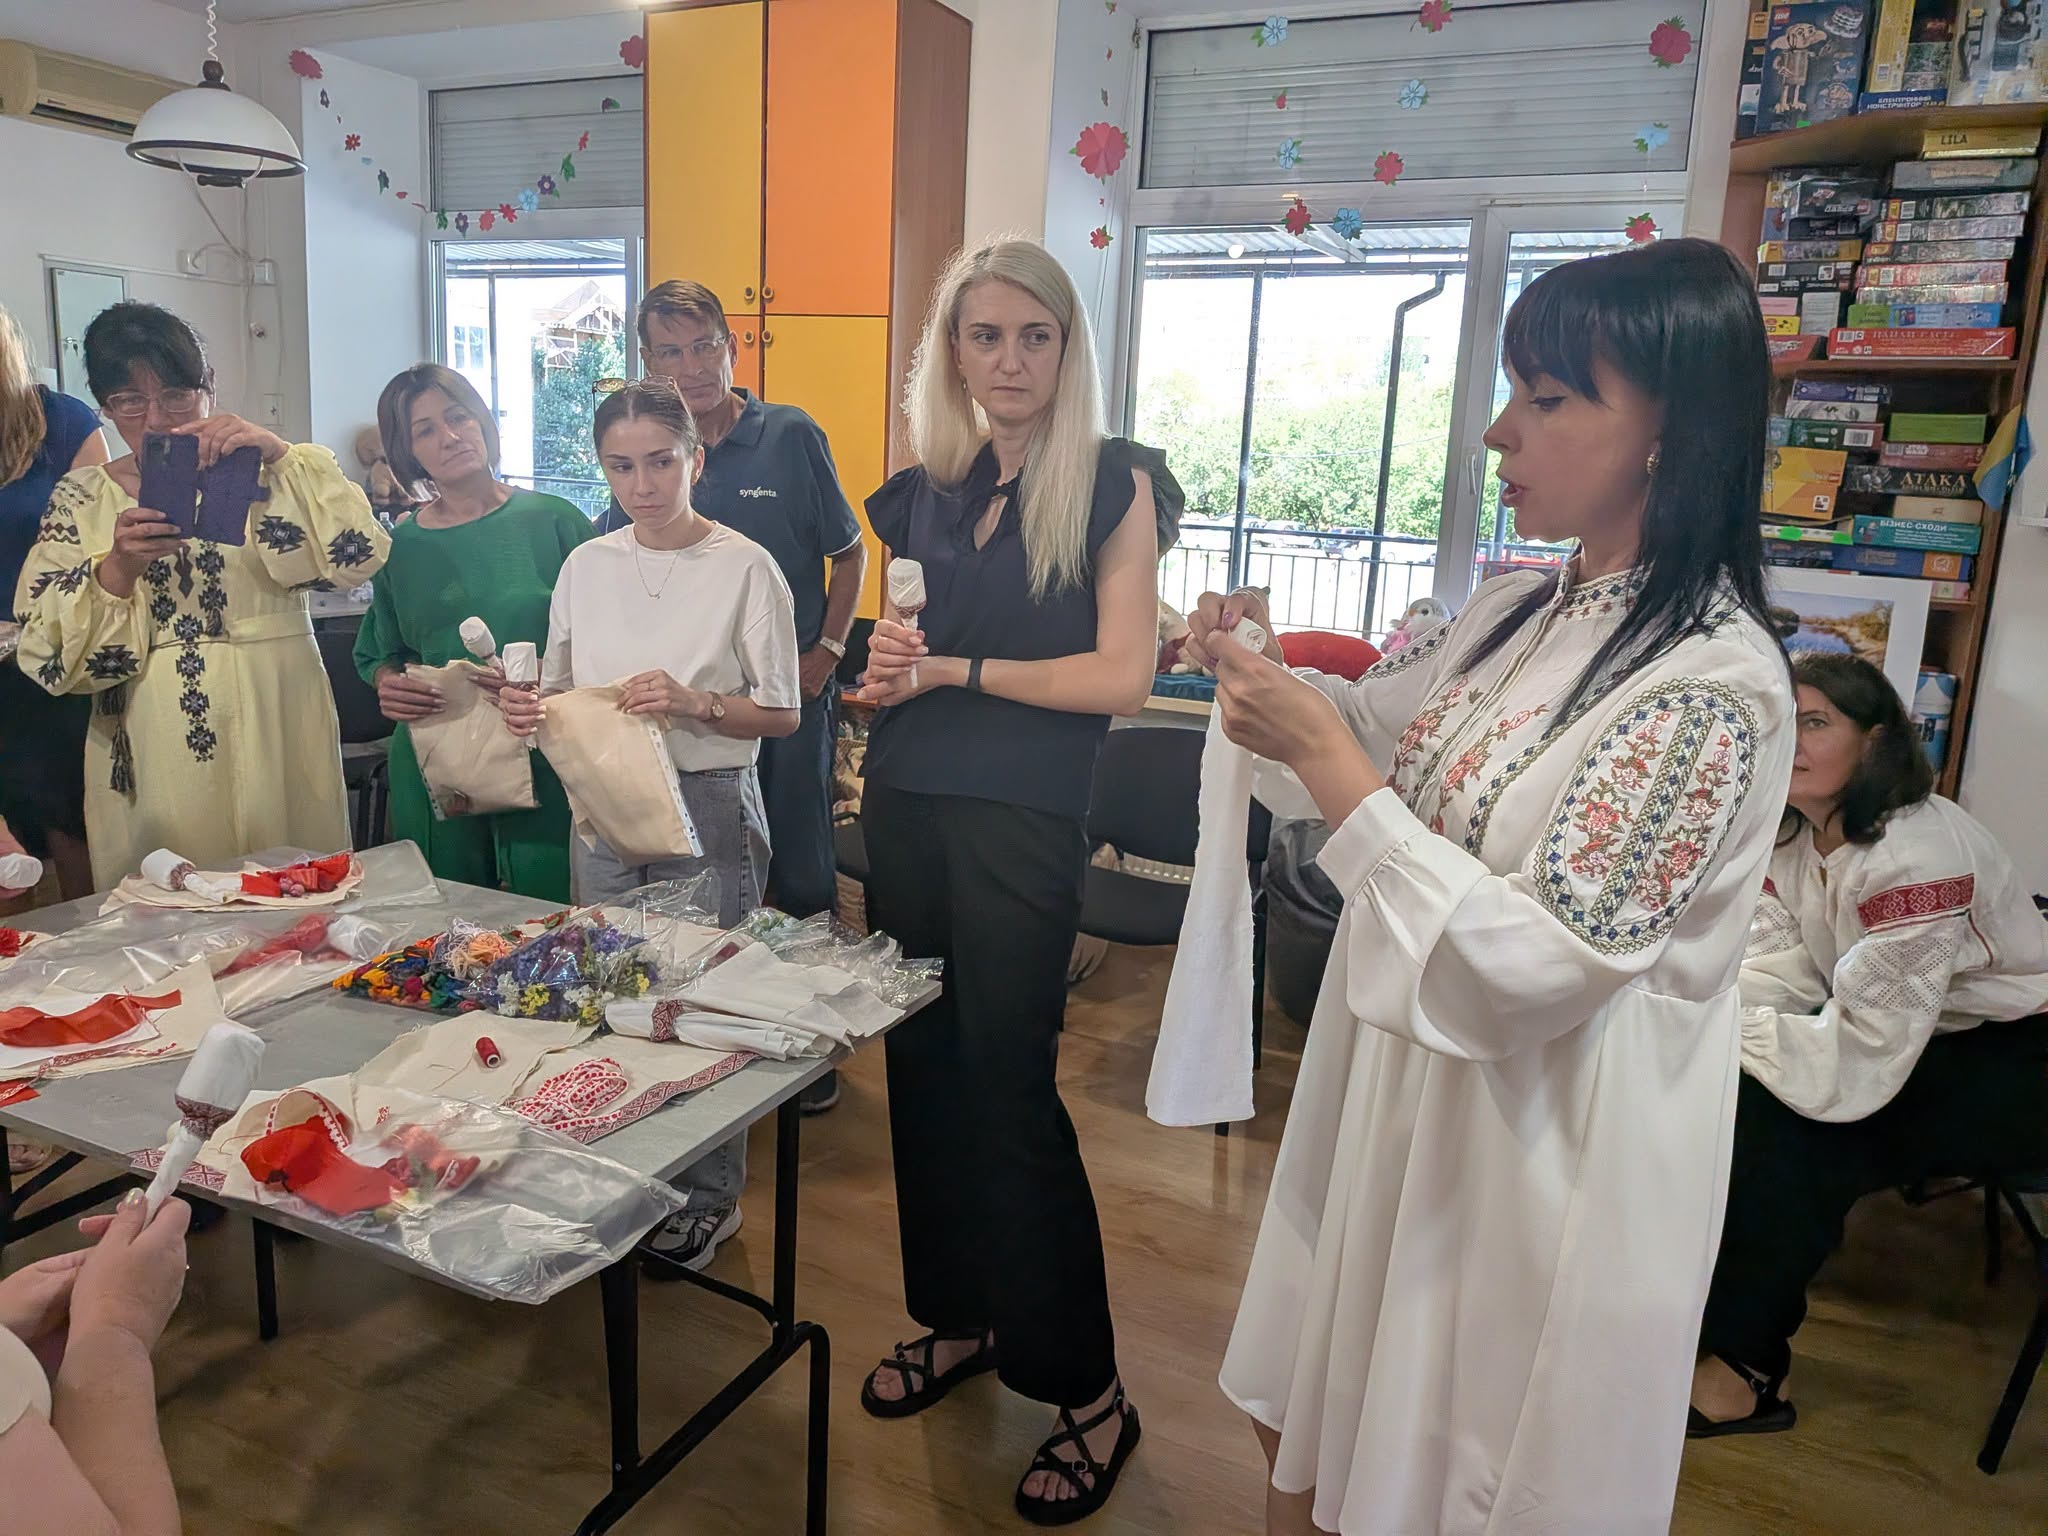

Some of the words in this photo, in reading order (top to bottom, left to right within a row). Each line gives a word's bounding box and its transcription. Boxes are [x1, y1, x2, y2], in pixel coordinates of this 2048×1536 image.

[1941, 134, 1967, 145] LILA
[1901, 472, 1967, 487] АТАКА
[739, 487, 777, 498] syngenta
